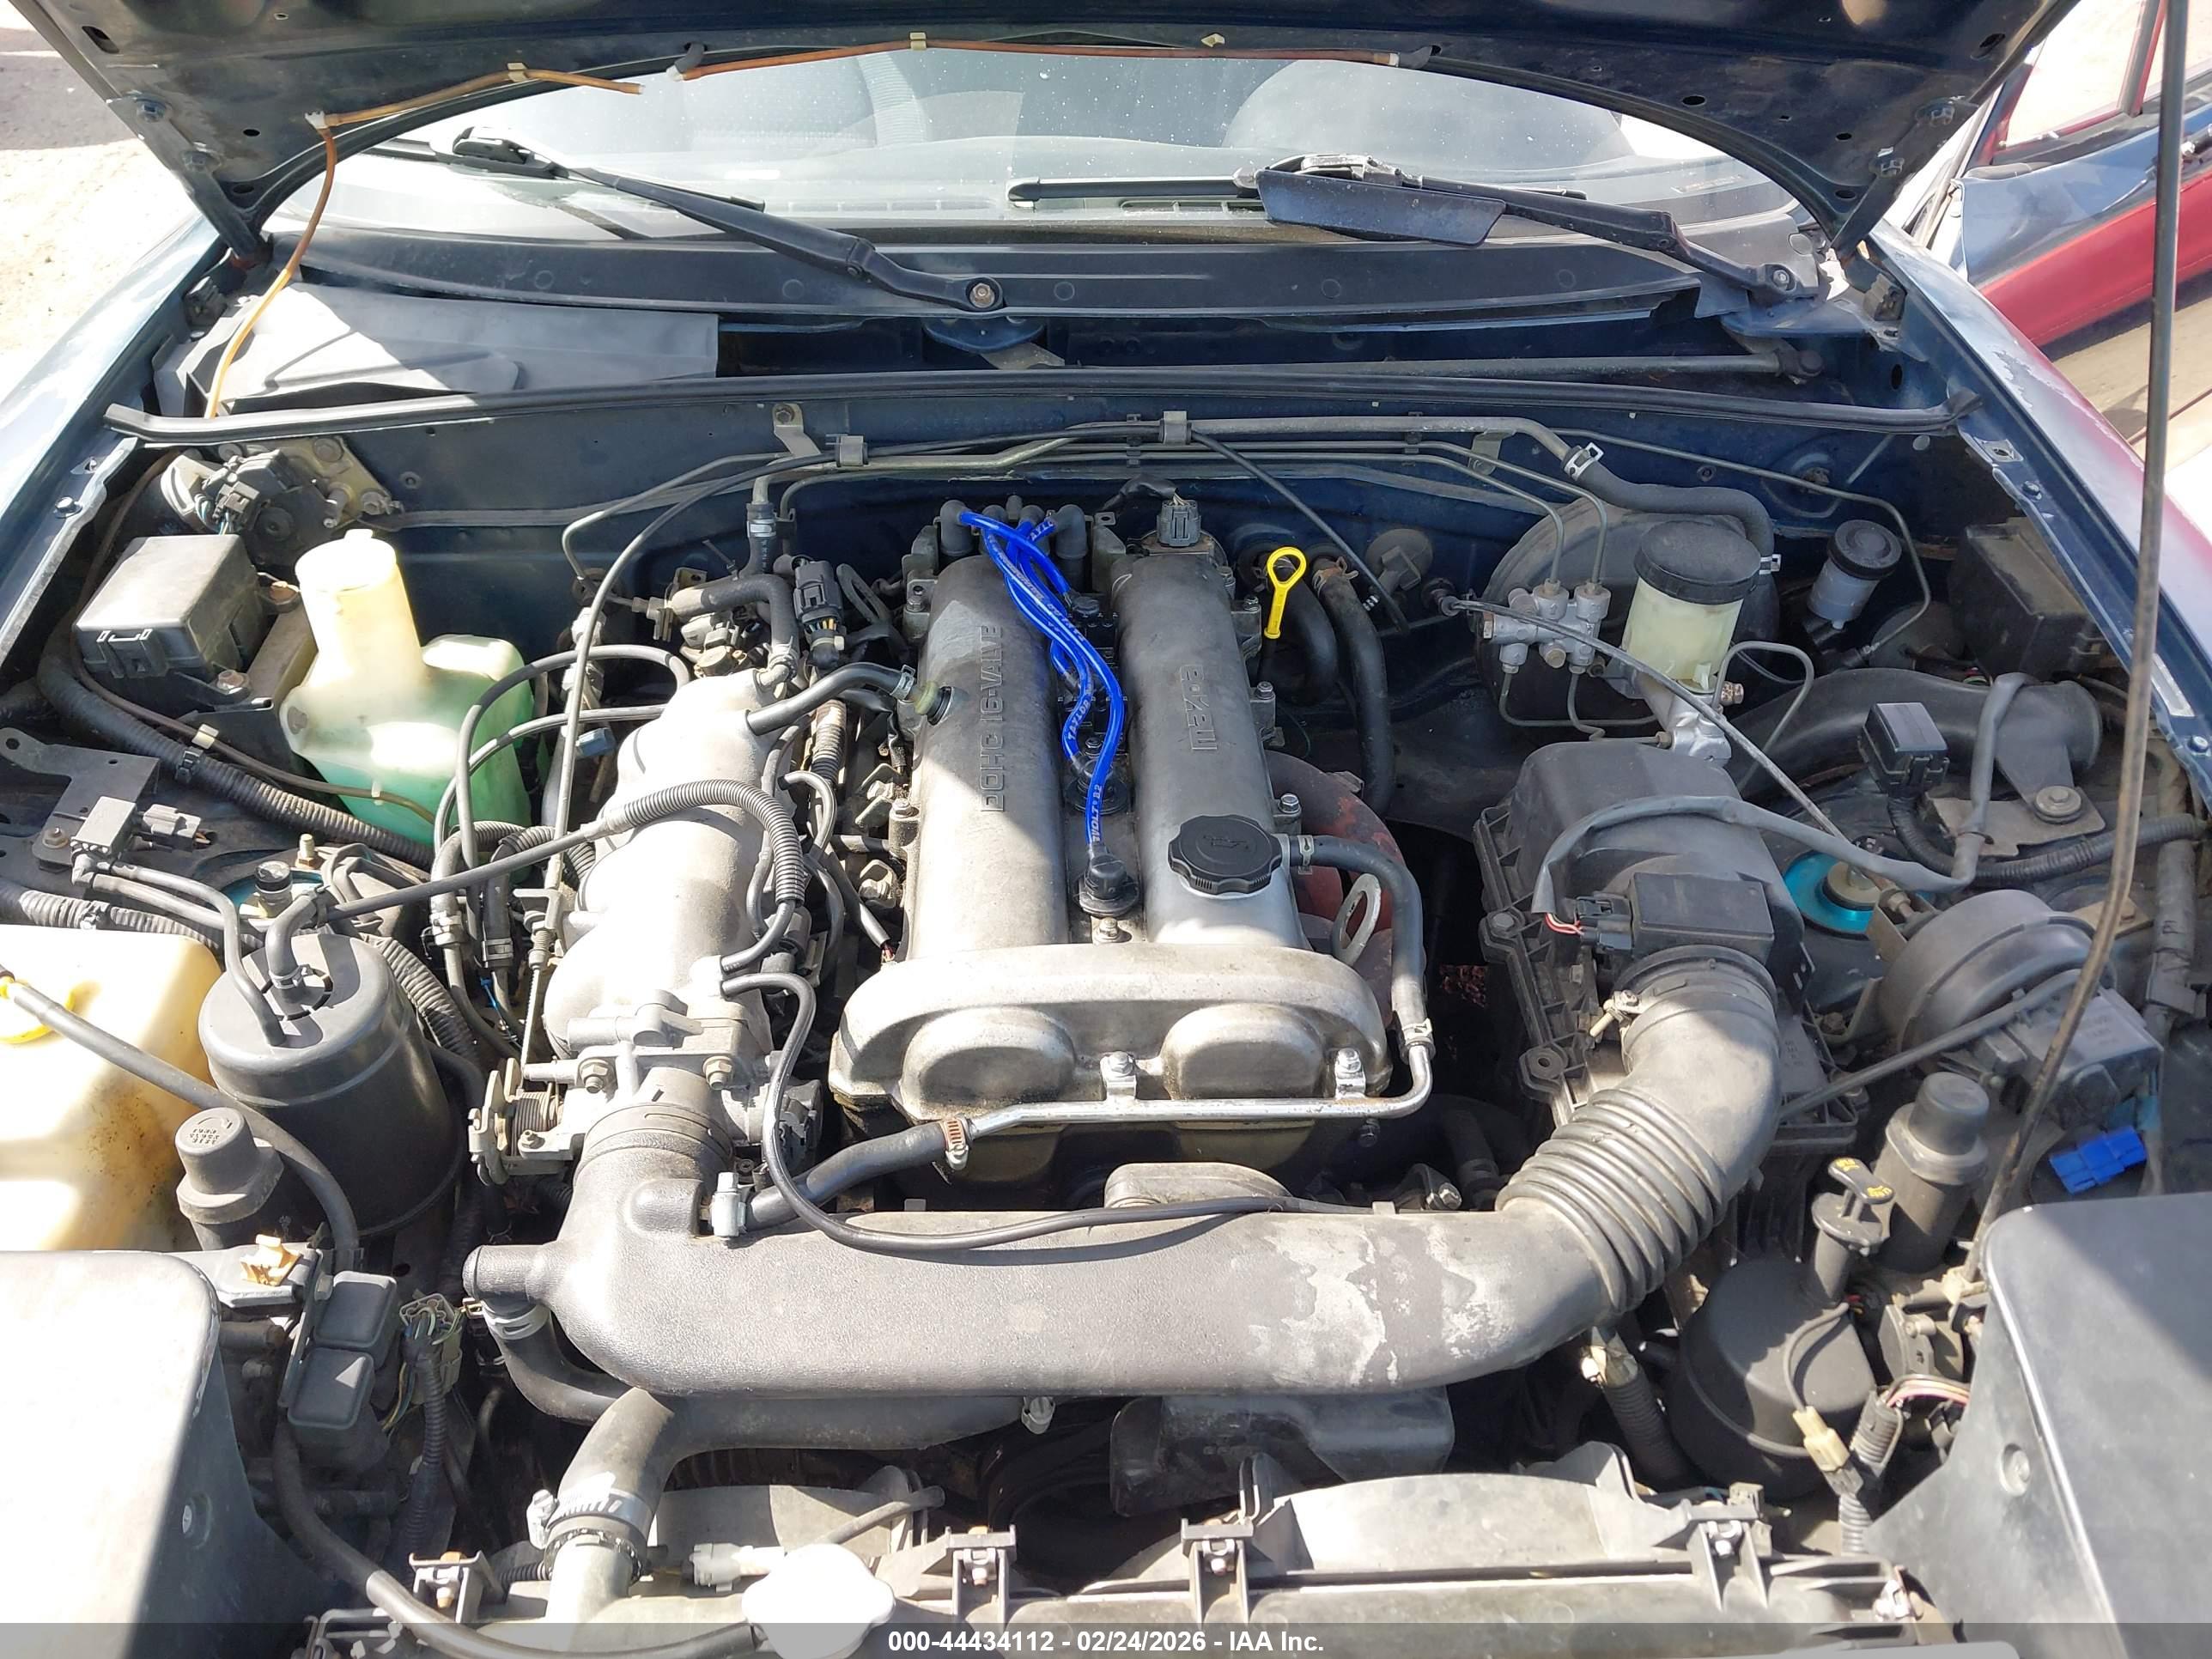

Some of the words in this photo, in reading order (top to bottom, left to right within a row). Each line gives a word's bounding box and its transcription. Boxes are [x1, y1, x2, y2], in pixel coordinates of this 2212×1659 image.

[979, 625, 1004, 721] 16-VALVE
[1067, 699, 1091, 740] TAYLOR
[979, 734, 1006, 812] DOHC
